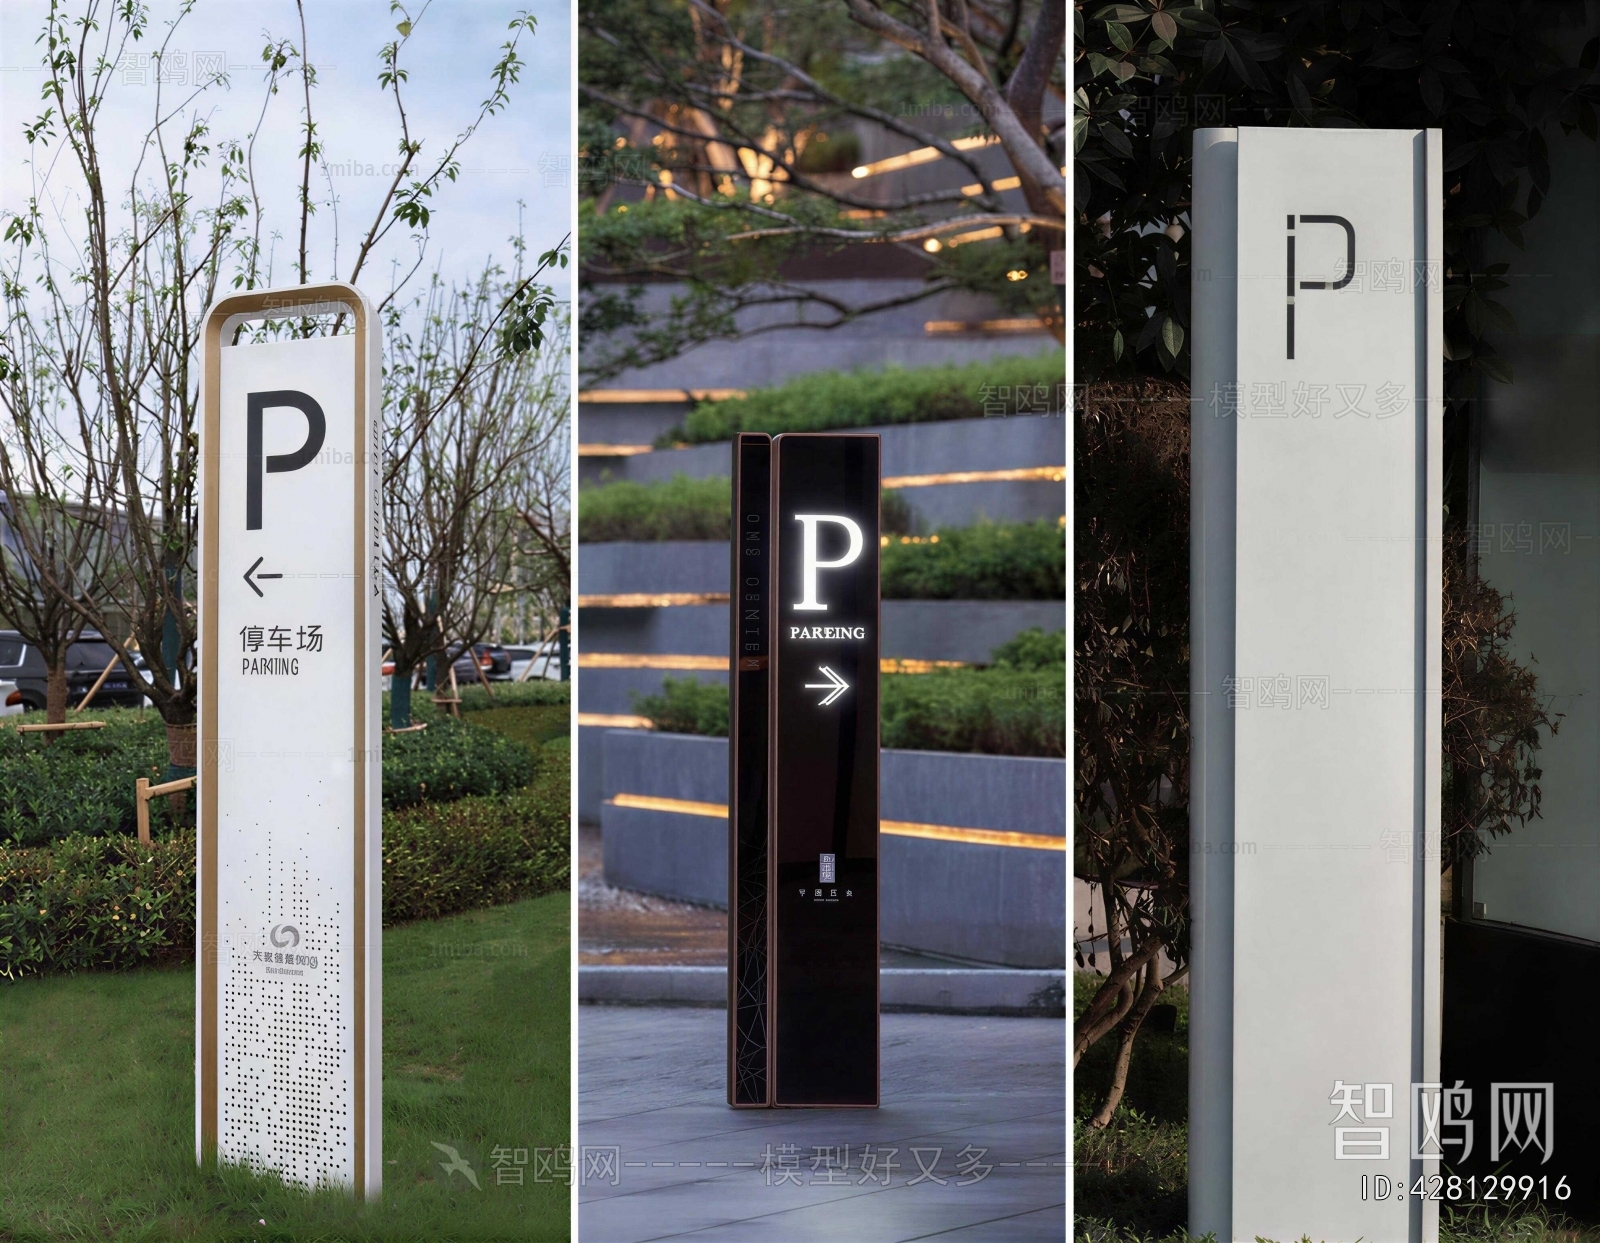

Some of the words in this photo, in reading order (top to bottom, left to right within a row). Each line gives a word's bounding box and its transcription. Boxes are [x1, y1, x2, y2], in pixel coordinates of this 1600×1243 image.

[1286, 214, 1356, 360] P
[245, 389, 327, 531] P
[793, 514, 864, 611] P
[239, 624, 324, 653] 停车场
